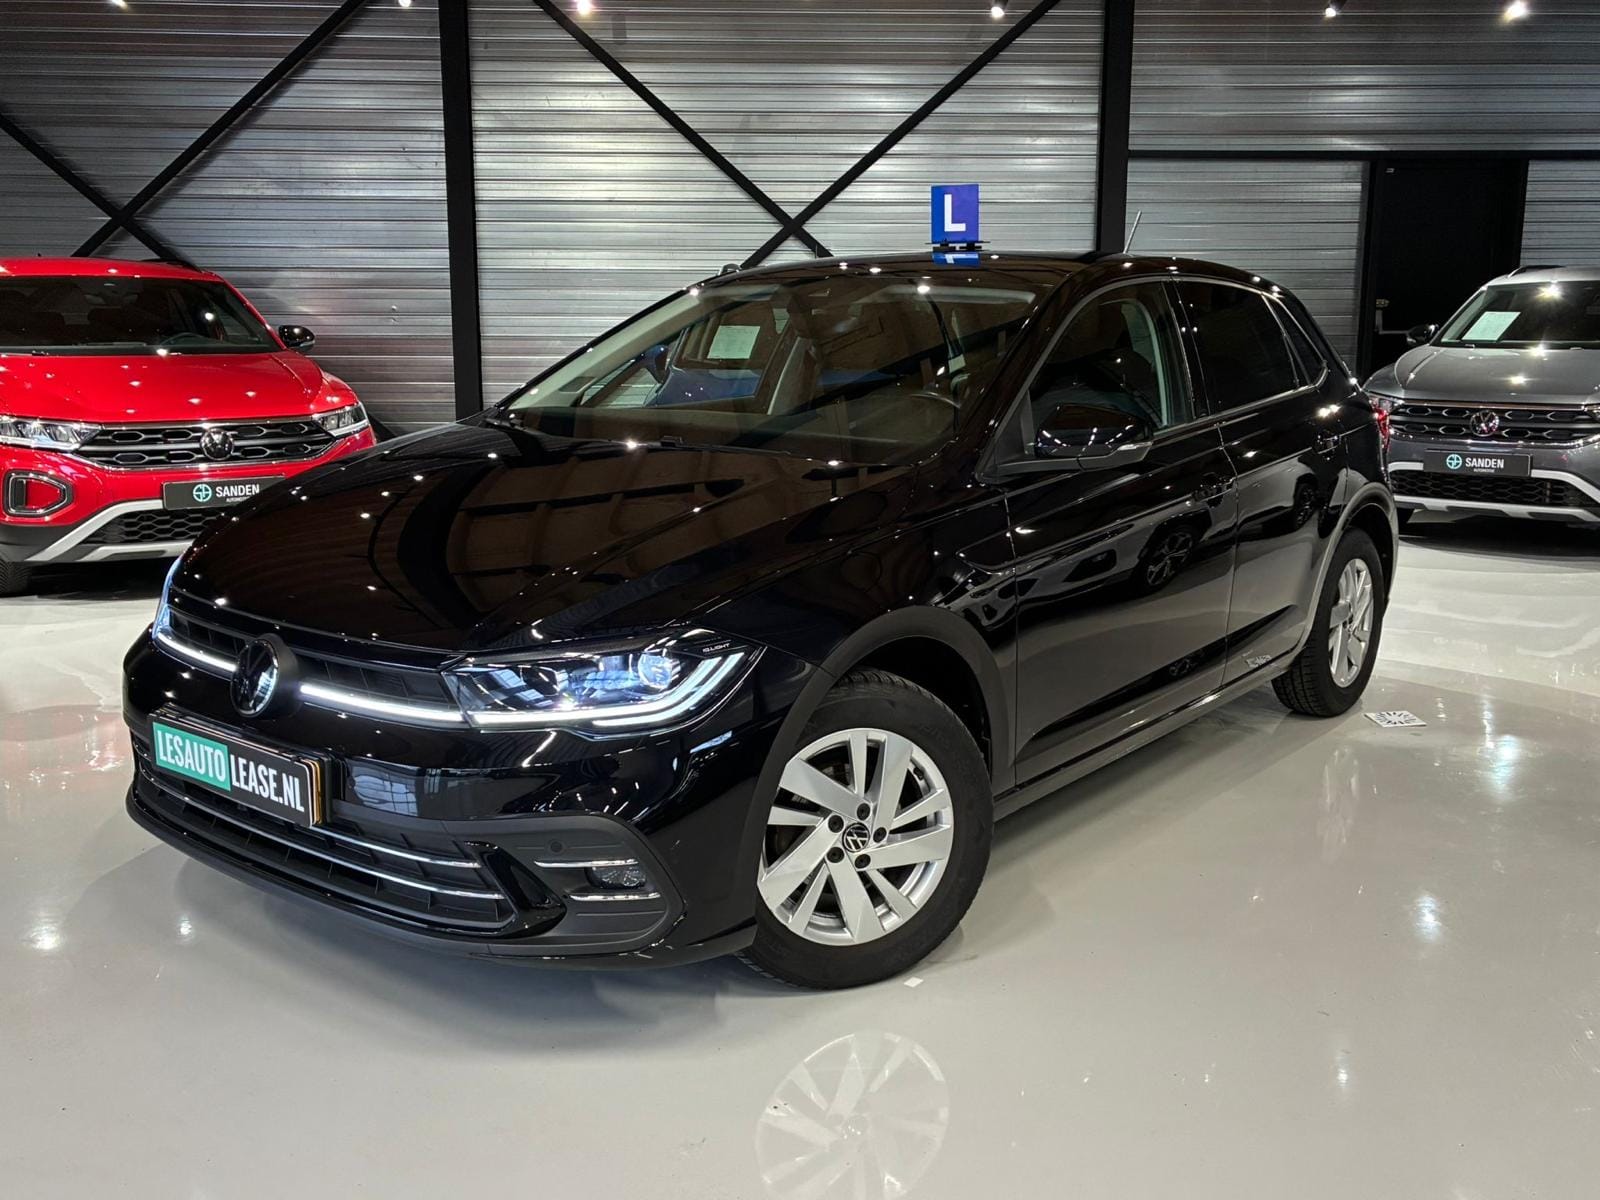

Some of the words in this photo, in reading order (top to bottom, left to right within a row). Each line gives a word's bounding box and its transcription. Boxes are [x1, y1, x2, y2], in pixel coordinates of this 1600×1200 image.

[944, 193, 967, 232] L
[1465, 457, 1504, 469] SANDEN
[215, 484, 260, 498] SANDEN
